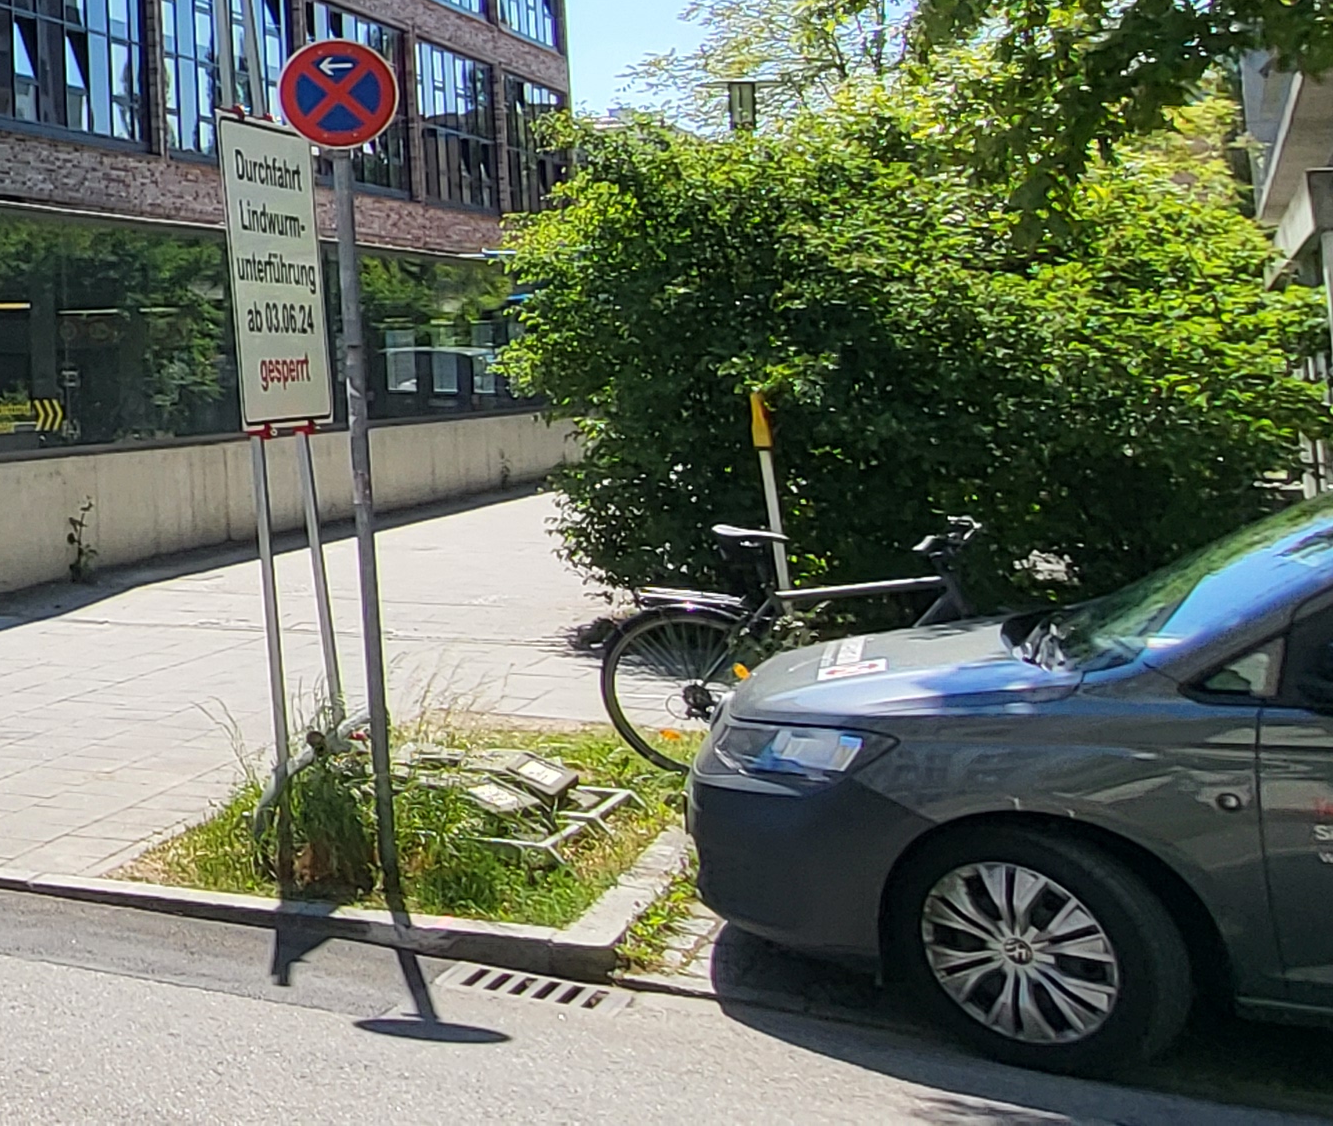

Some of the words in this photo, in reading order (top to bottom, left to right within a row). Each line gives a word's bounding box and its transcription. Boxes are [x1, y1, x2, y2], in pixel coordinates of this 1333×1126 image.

[235, 149, 303, 192] Durchfahrt
[239, 199, 306, 239] Lindwurm-
[237, 252, 317, 295] unterführung
[247, 301, 263, 333] ab
[265, 302, 314, 334] 03.06.24
[260, 353, 311, 391] gesperrt
